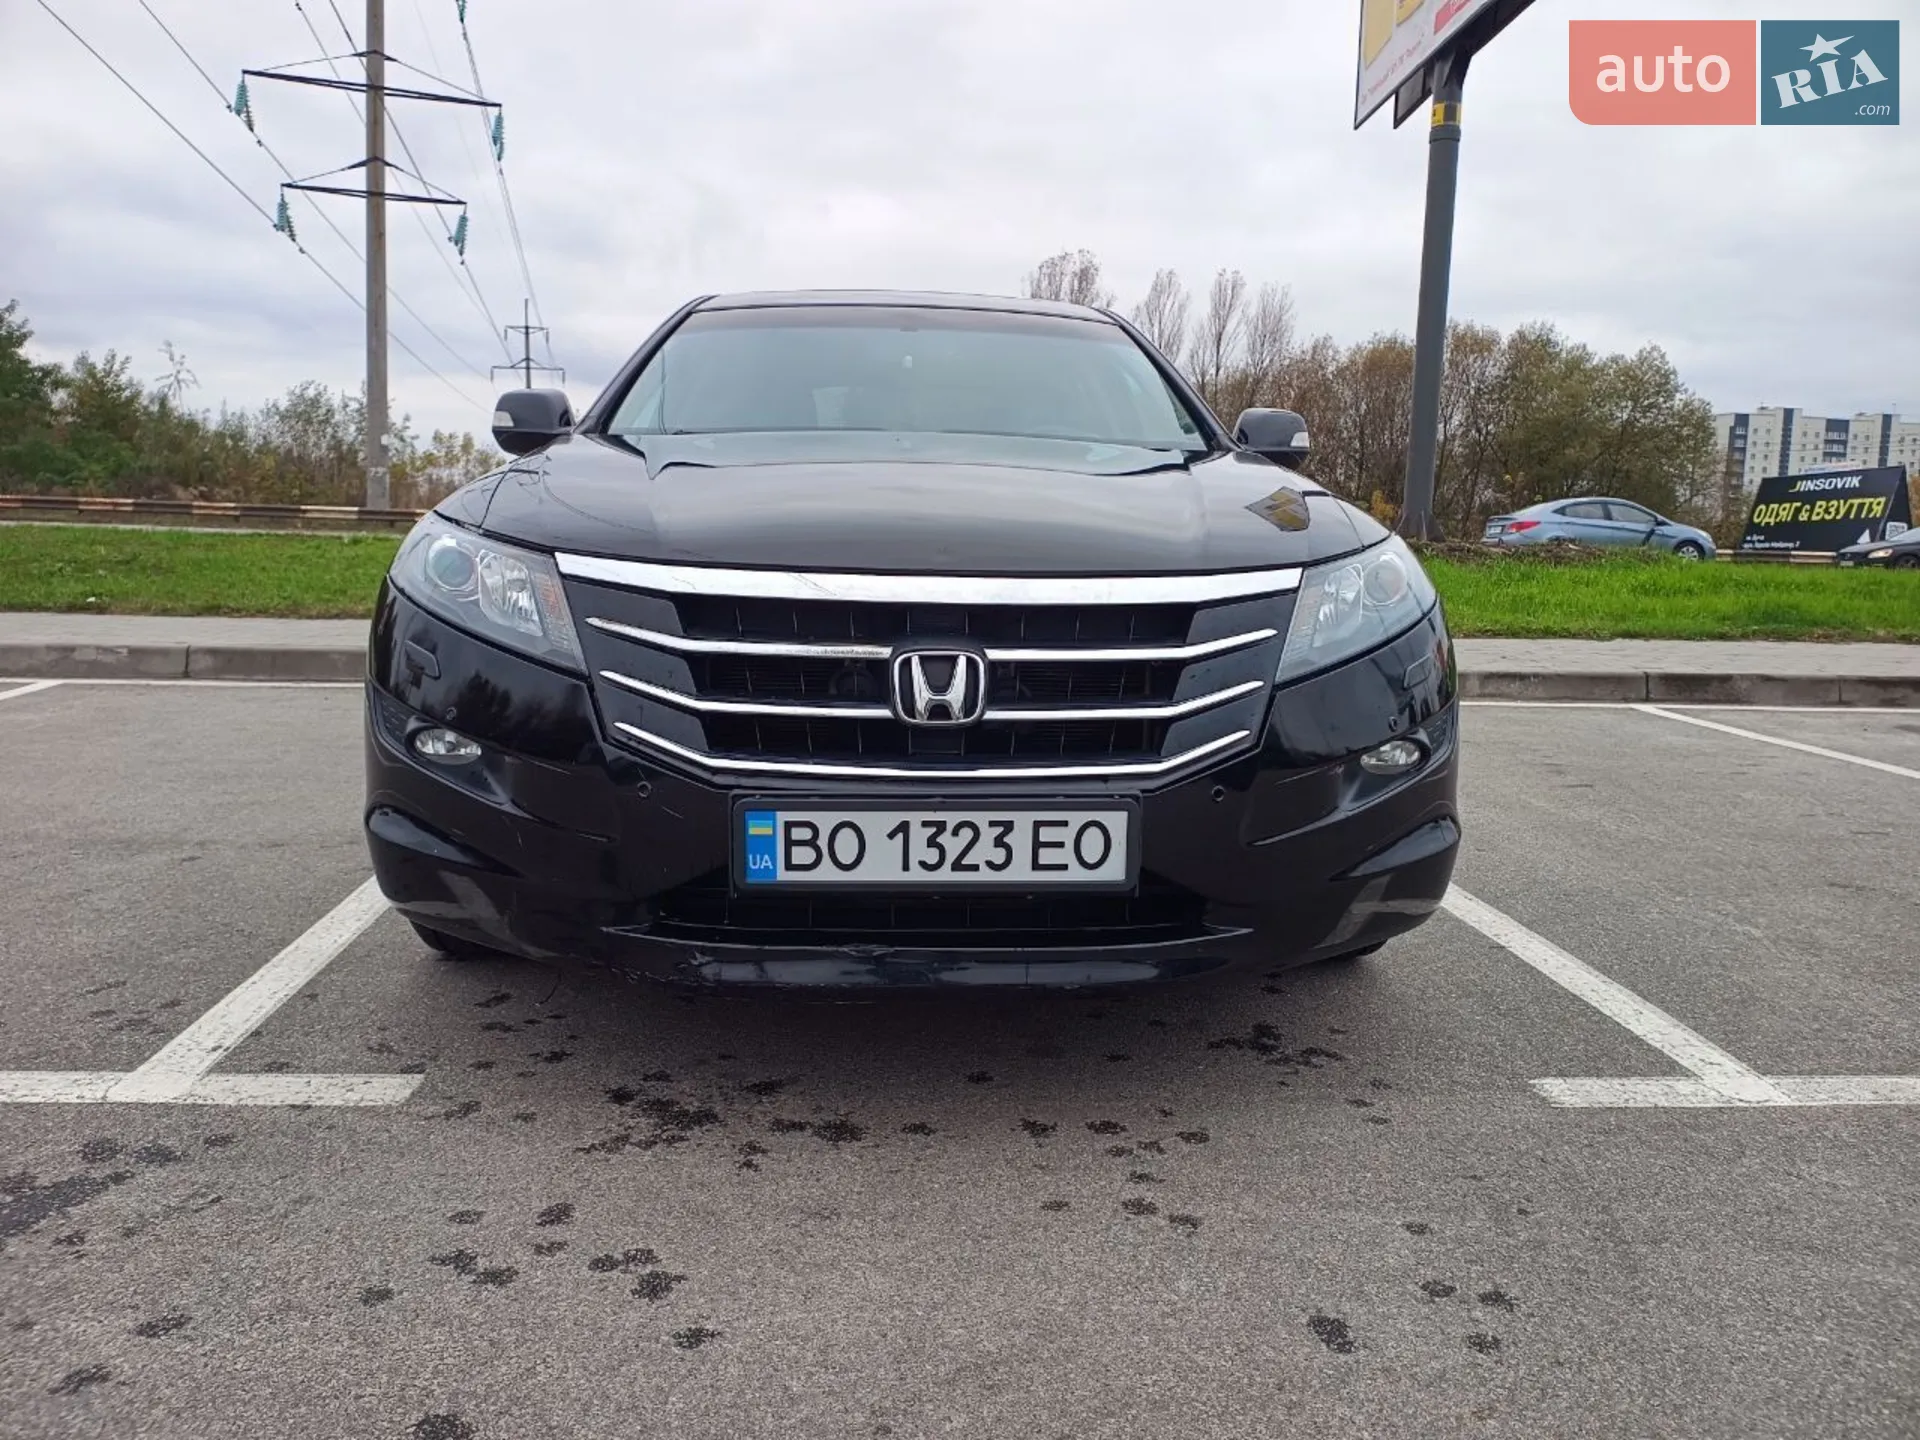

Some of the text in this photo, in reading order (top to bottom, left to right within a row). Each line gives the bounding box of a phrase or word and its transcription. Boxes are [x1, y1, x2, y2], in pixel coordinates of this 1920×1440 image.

[1789, 476, 1862, 492] JINSOVIK
[783, 820, 1112, 872] BO 1323 EO
[748, 854, 773, 870] UA
